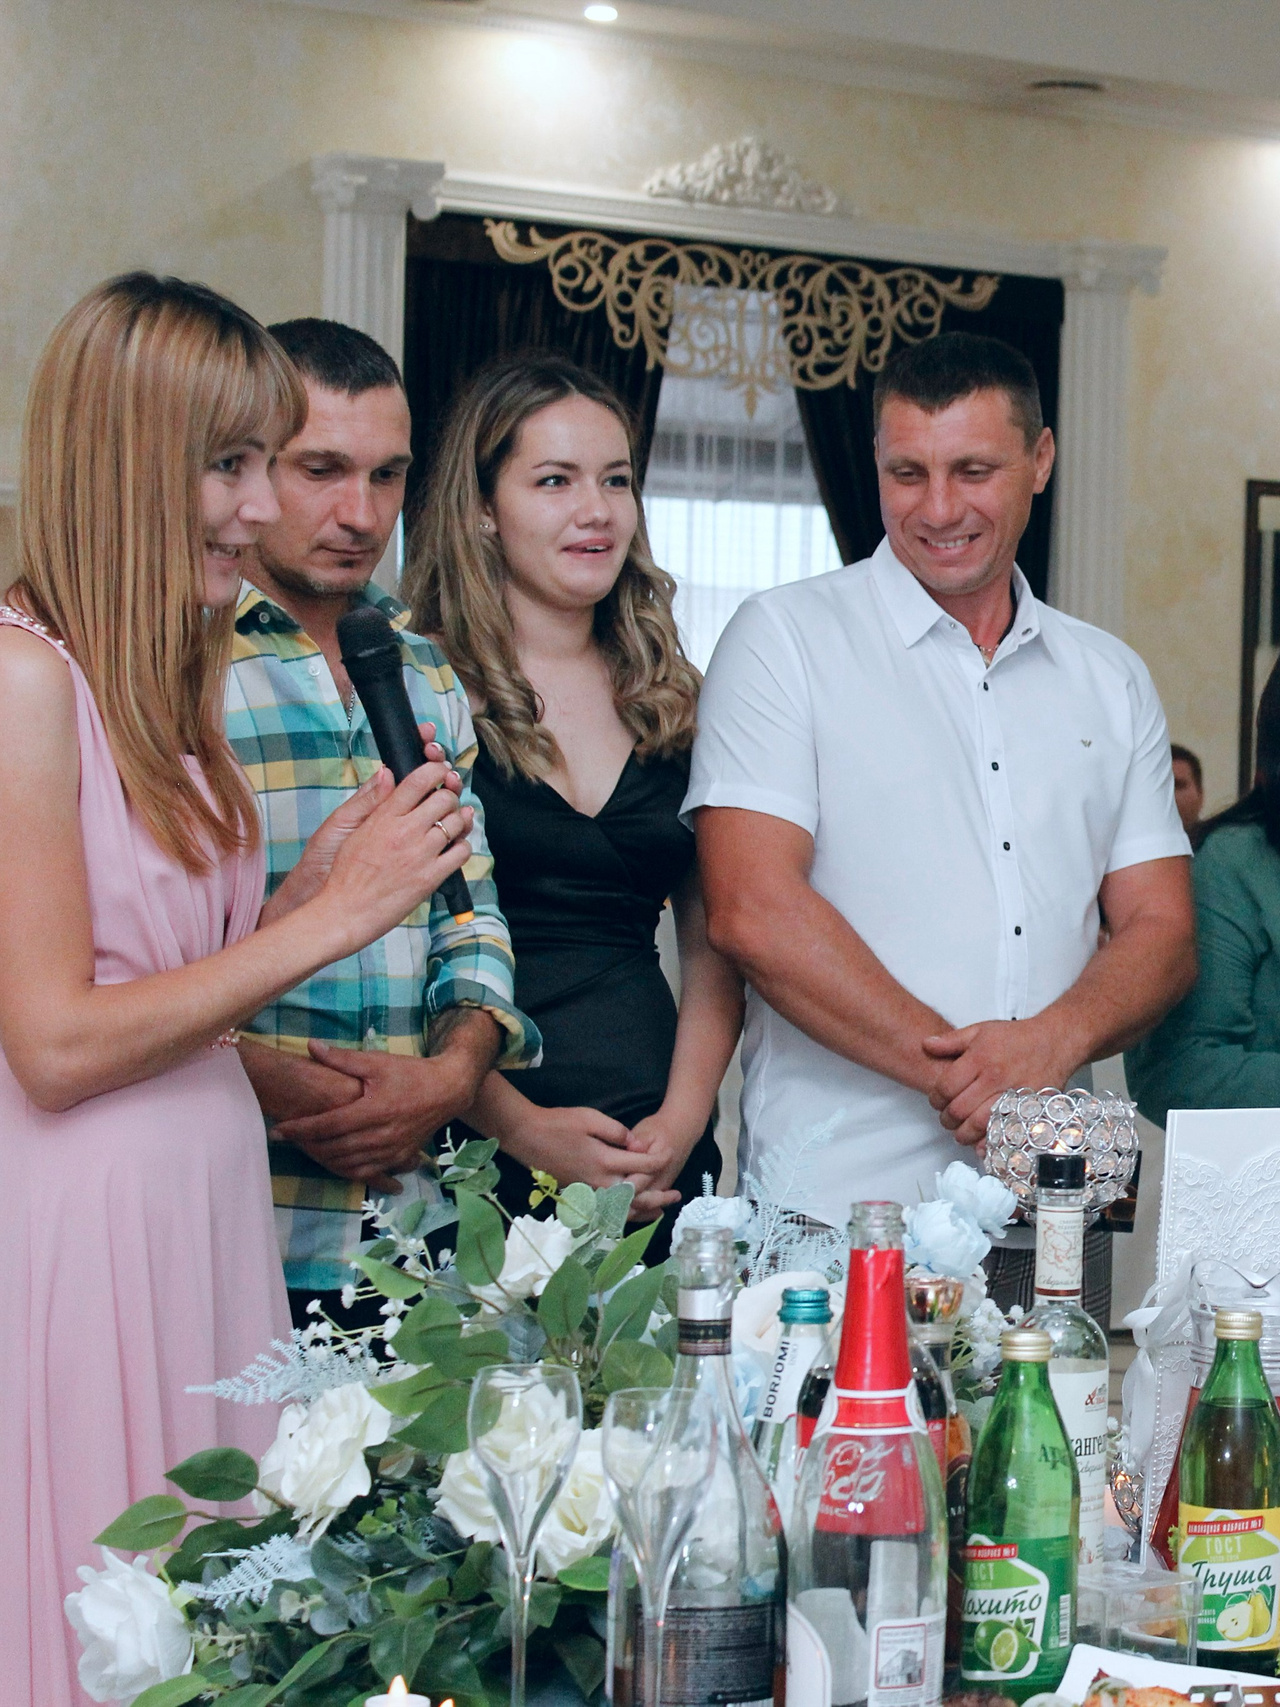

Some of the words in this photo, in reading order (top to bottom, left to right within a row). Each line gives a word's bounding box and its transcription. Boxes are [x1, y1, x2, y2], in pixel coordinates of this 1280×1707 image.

[763, 1341, 790, 1418] BORJOMI
[1205, 1536, 1243, 1555] ГОСТ
[963, 1589, 1042, 1615] охито
